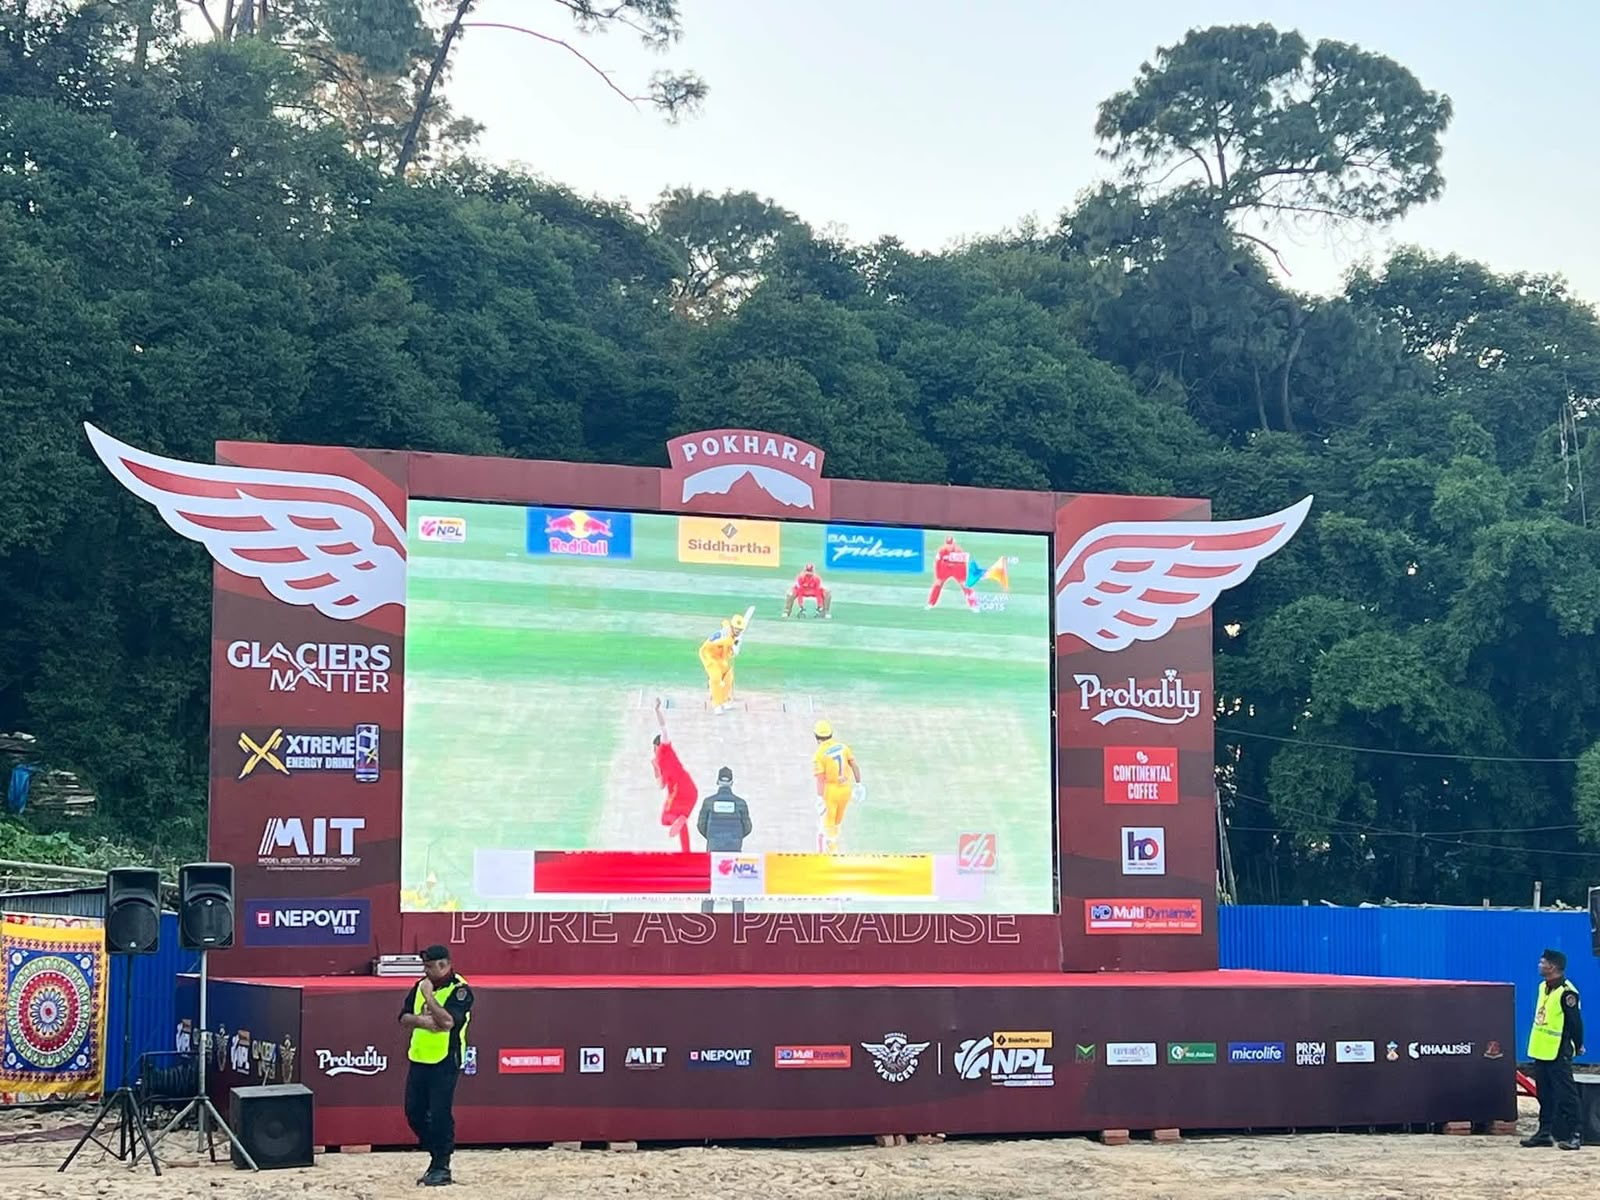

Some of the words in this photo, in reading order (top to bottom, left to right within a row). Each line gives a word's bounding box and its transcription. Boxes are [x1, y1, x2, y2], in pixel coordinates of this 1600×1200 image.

[682, 435, 816, 470] POKHARA
[551, 538, 577, 553] Red
[581, 540, 608, 555] Bull
[688, 539, 771, 554] Siddhartha
[828, 533, 873, 544] BAJAJ
[227, 641, 391, 671] GLACIERS
[270, 668, 389, 692] MATTER
[1072, 672, 1201, 722] Probably
[286, 735, 355, 754] XTREME
[286, 757, 323, 768] ENERGY
[325, 757, 355, 769] DRINK
[1113, 765, 1172, 782] CONTINENTAL
[1128, 783, 1159, 800] COFFEE
[258, 818, 365, 855] MIT
[275, 910, 360, 927] NEPOVIT
[334, 926, 356, 935] TILES
[450, 912, 618, 944] PURE
[633, 912, 717, 944] AS
[733, 912, 1020, 944] PARADISE
[625, 1048, 667, 1064] MIT
[701, 1050, 752, 1061] NEPOVIT
[1232, 1045, 1282, 1060] microlife
[1296, 1042, 1326, 1055] PRISM
[315, 1047, 387, 1075] Probably
[991, 1049, 1053, 1074] NPL
[1296, 1054, 1325, 1066] EFFECT
[873, 1058, 919, 1083] AVENGERS
